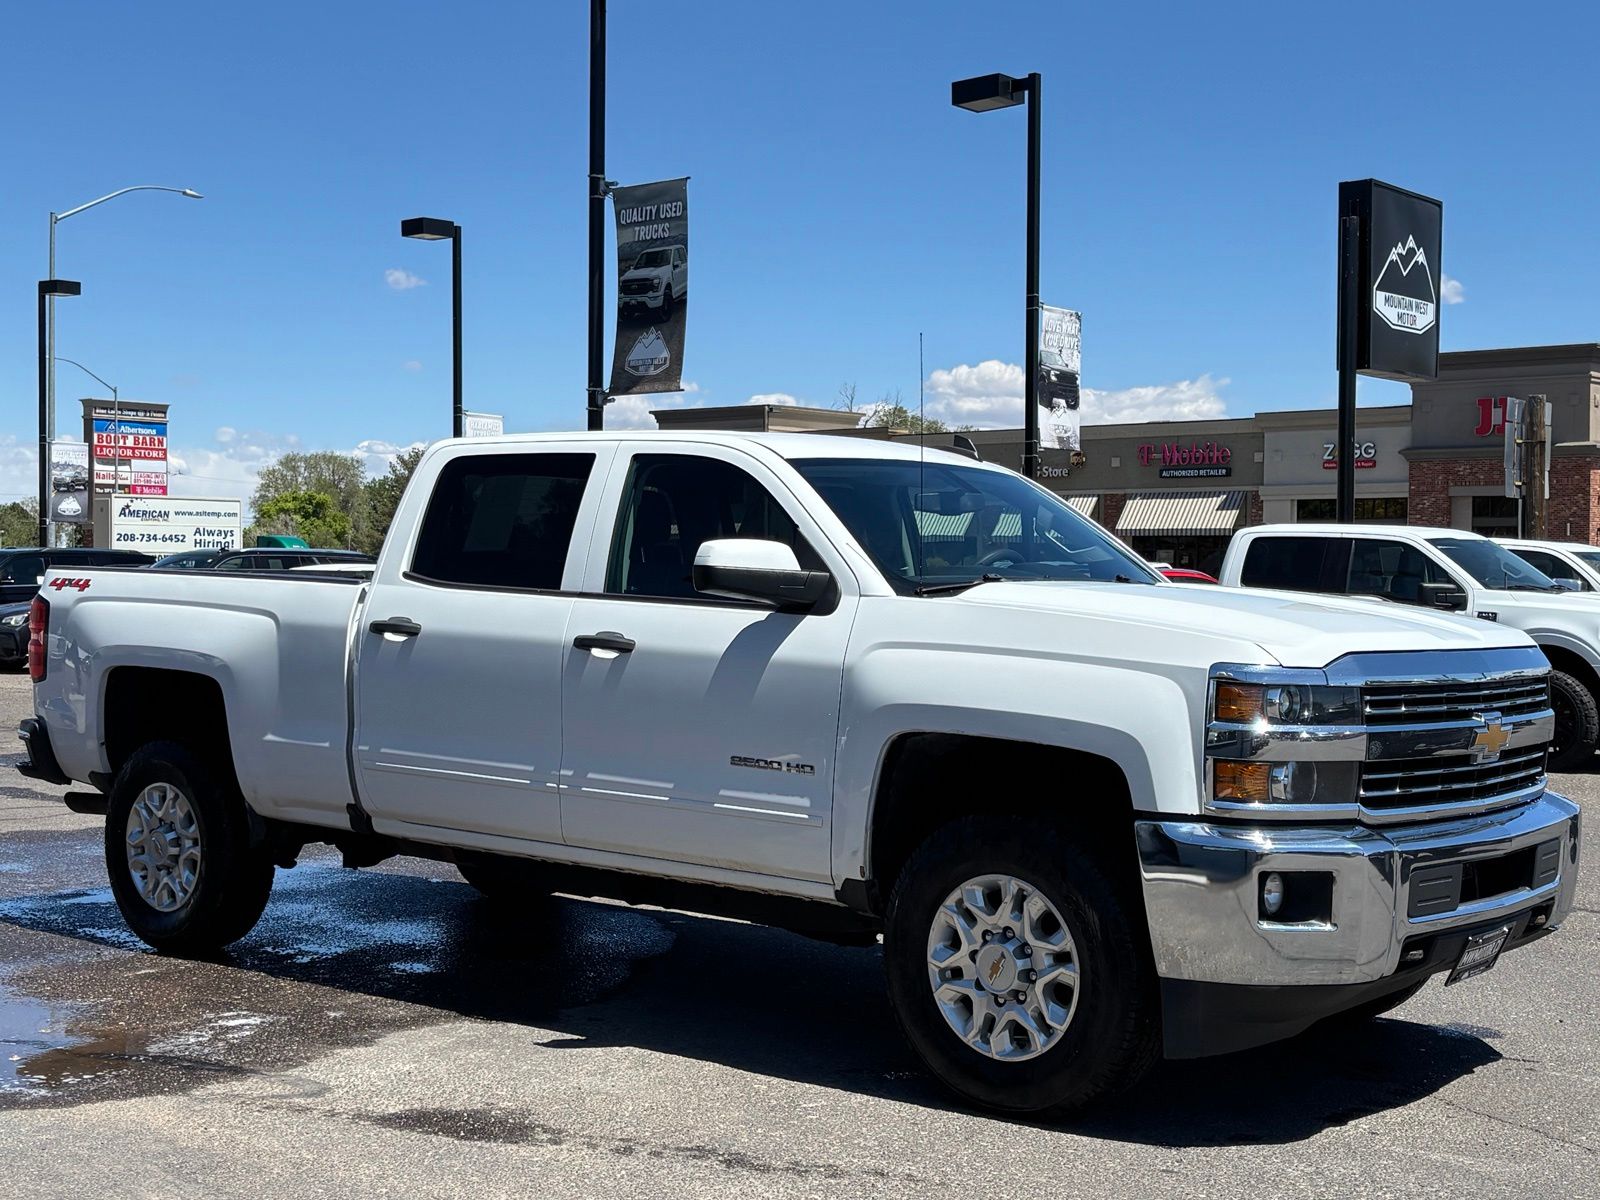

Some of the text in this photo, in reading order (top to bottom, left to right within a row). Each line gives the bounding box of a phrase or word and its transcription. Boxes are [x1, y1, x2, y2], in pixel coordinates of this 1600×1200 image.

[620, 201, 683, 225] QUALITY USED
[634, 223, 670, 241] TRUCKS
[1384, 294, 1429, 316] MOUNTAIN WEST
[1396, 312, 1417, 327] MOTOR
[119, 425, 157, 435] Albertsons
[97, 433, 164, 448] BOOT BARN
[134, 449, 165, 458] STORE
[1323, 442, 1376, 460] ZGG
[95, 471, 116, 481] Nails
[1042, 466, 1069, 477] Store
[119, 507, 170, 519] AMERICAN
[116, 533, 187, 543] 208-734-6452
[193, 527, 235, 539] Always
[194, 538, 235, 549] Hiring!
[48, 577, 92, 592] 4x4
[730, 755, 815, 776] 2500 HD
